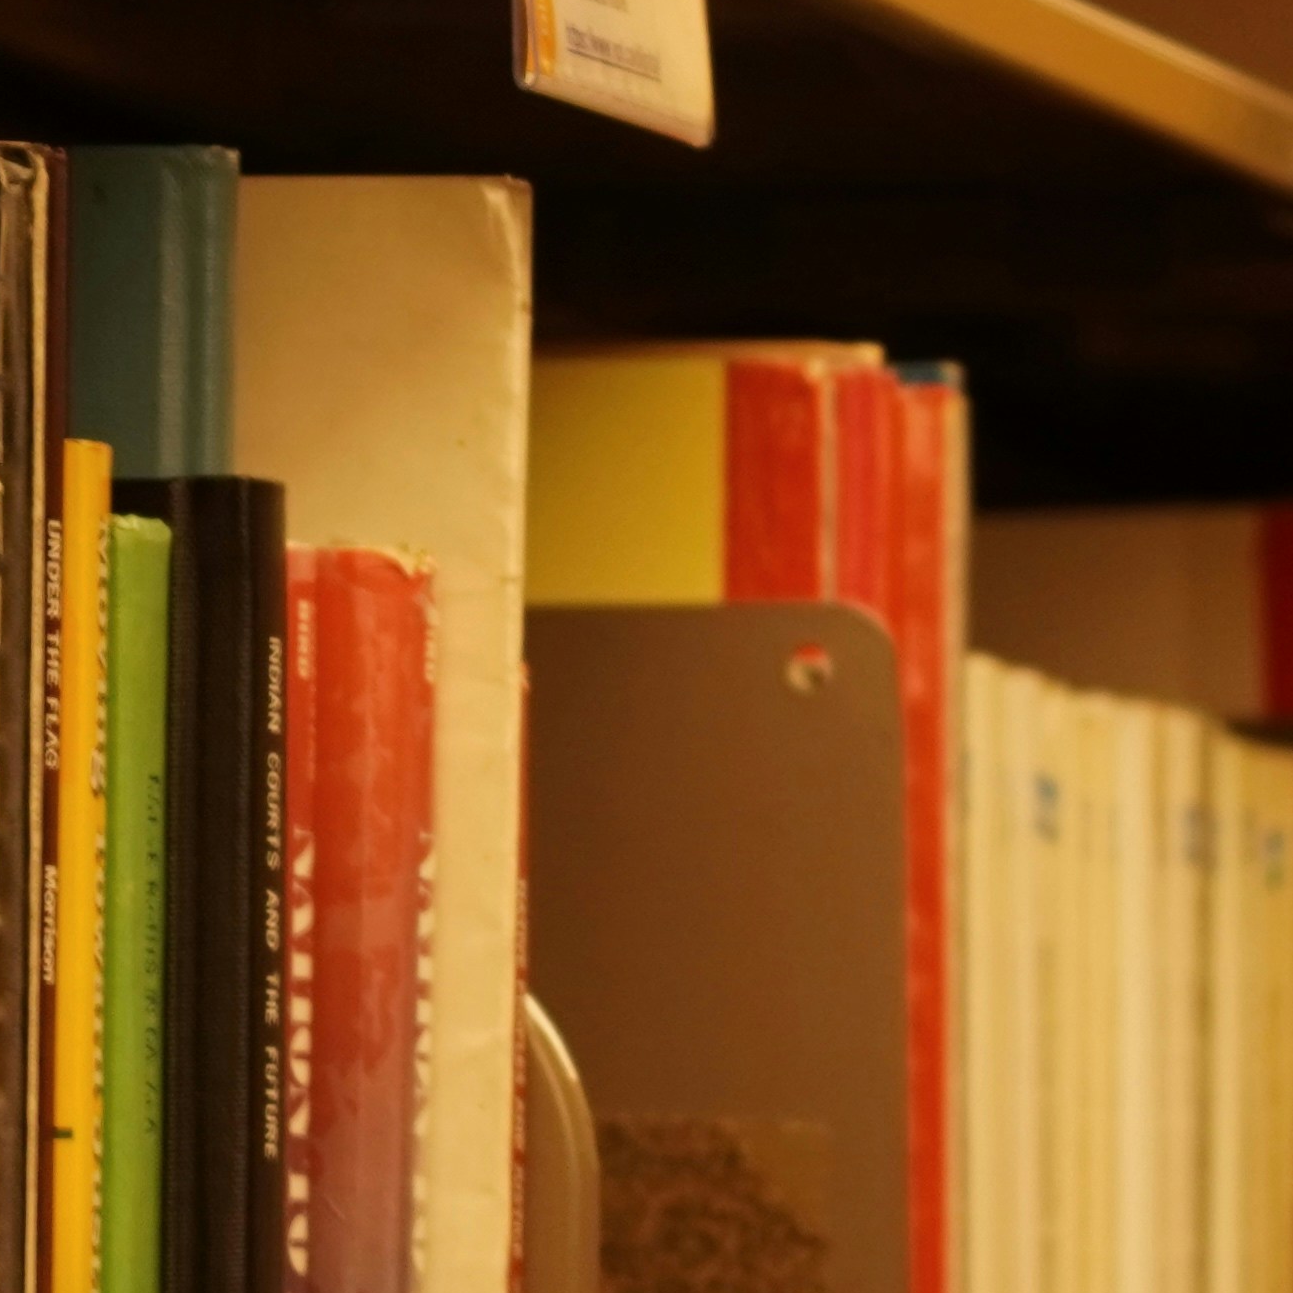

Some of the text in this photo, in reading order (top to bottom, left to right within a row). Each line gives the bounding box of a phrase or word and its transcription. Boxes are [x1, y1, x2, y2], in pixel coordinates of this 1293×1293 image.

[44, 518, 62, 770] UNDER THE FLAG
[42, 863, 58, 986] Morrison
[263, 636, 283, 1160] INDIAN COURTS AND THE FUTURE
[289, 824, 316, 1138] NATION
[286, 1169, 310, 1277] TO
